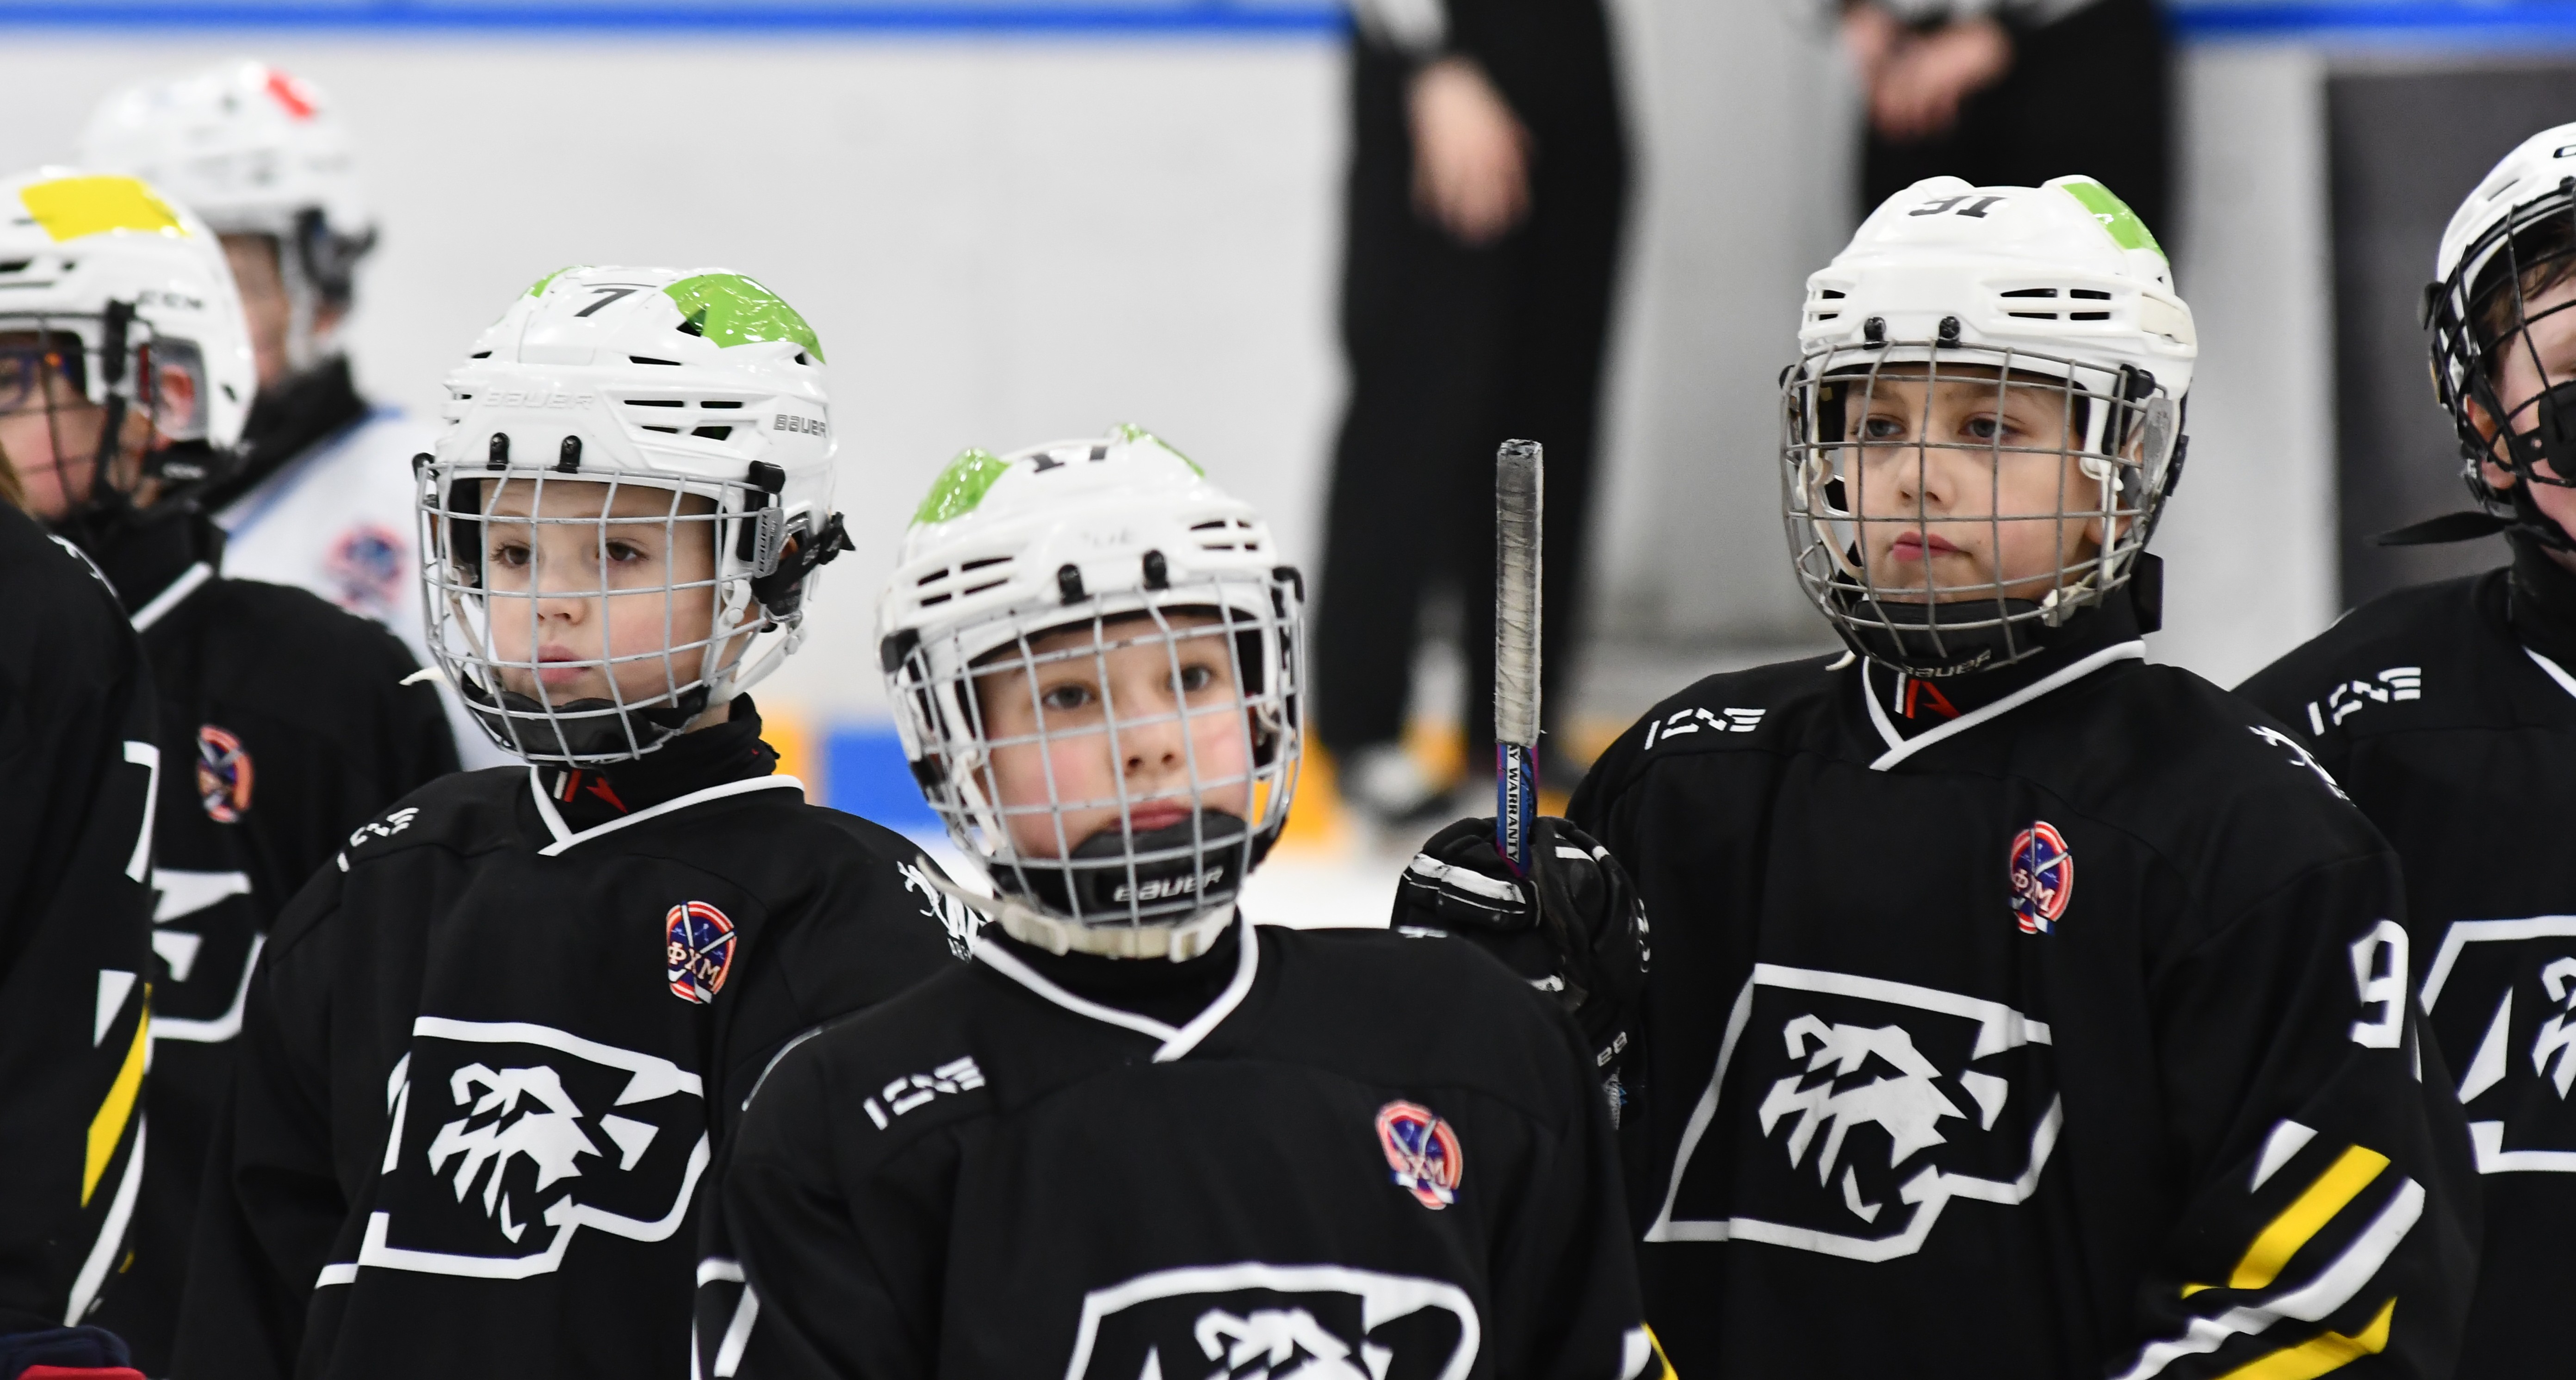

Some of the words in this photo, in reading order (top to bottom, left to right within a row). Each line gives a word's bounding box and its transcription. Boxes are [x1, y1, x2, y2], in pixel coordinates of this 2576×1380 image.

[573, 288, 638, 317] 7
[773, 414, 826, 438] BAUER
[1508, 767, 1518, 860] WARRANTY
[667, 941, 721, 986] ФХМ
[2350, 919, 2422, 1083] 9
